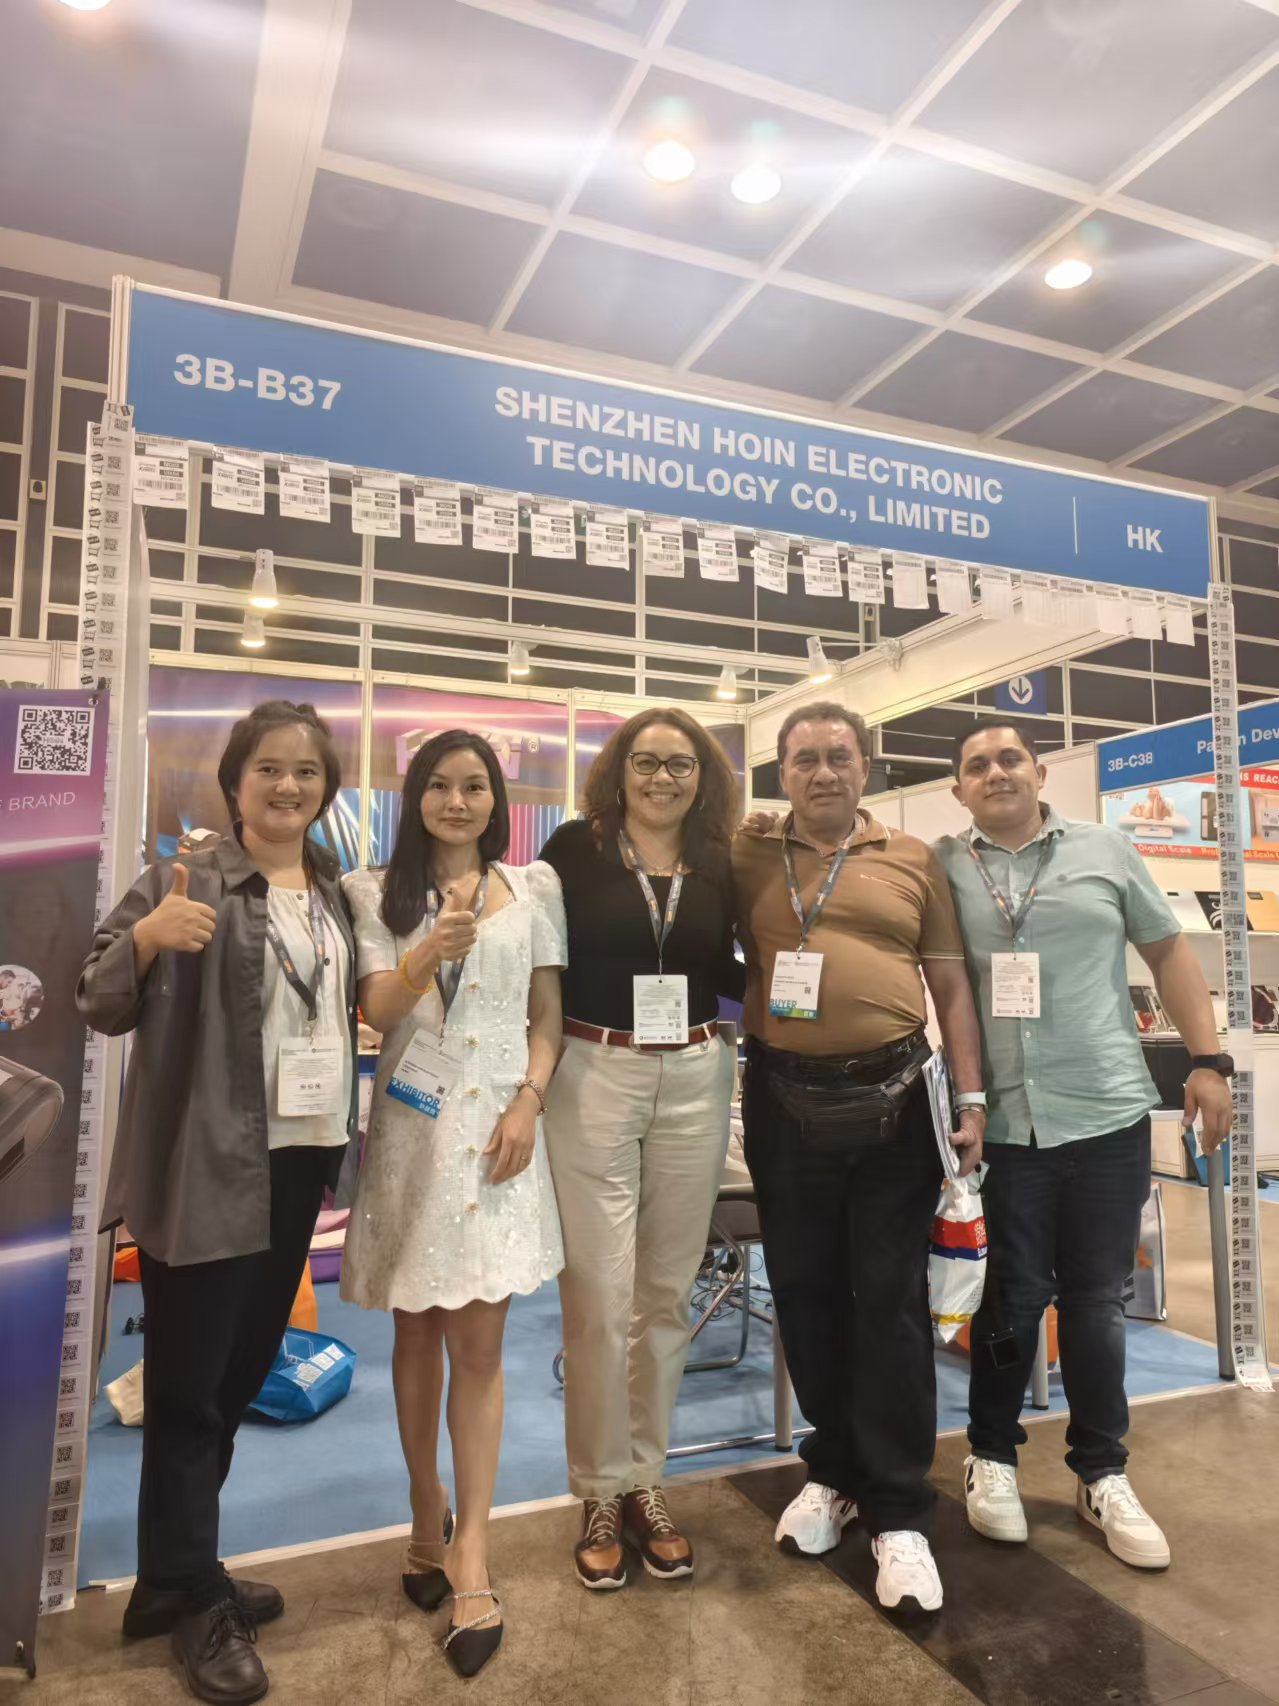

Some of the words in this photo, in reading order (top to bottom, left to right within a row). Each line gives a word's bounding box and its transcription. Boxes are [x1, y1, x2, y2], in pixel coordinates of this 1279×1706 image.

[174, 353, 342, 410] 3B-B37
[494, 386, 700, 450] SHENZHEN
[713, 426, 796, 467] HOIN
[807, 444, 1003, 504] ELECTRONIC
[526, 435, 780, 504] TECHNOLOGY
[790, 482, 857, 524] CO.,
[868, 494, 991, 539] LIMITED
[1127, 524, 1163, 552] HK
[1107, 752, 1153, 771] 3B-C38
[8, 791, 76, 811] BRAND
[770, 998, 797, 1009] BUYER
[391, 1077, 440, 1106] EXHIBITOR
